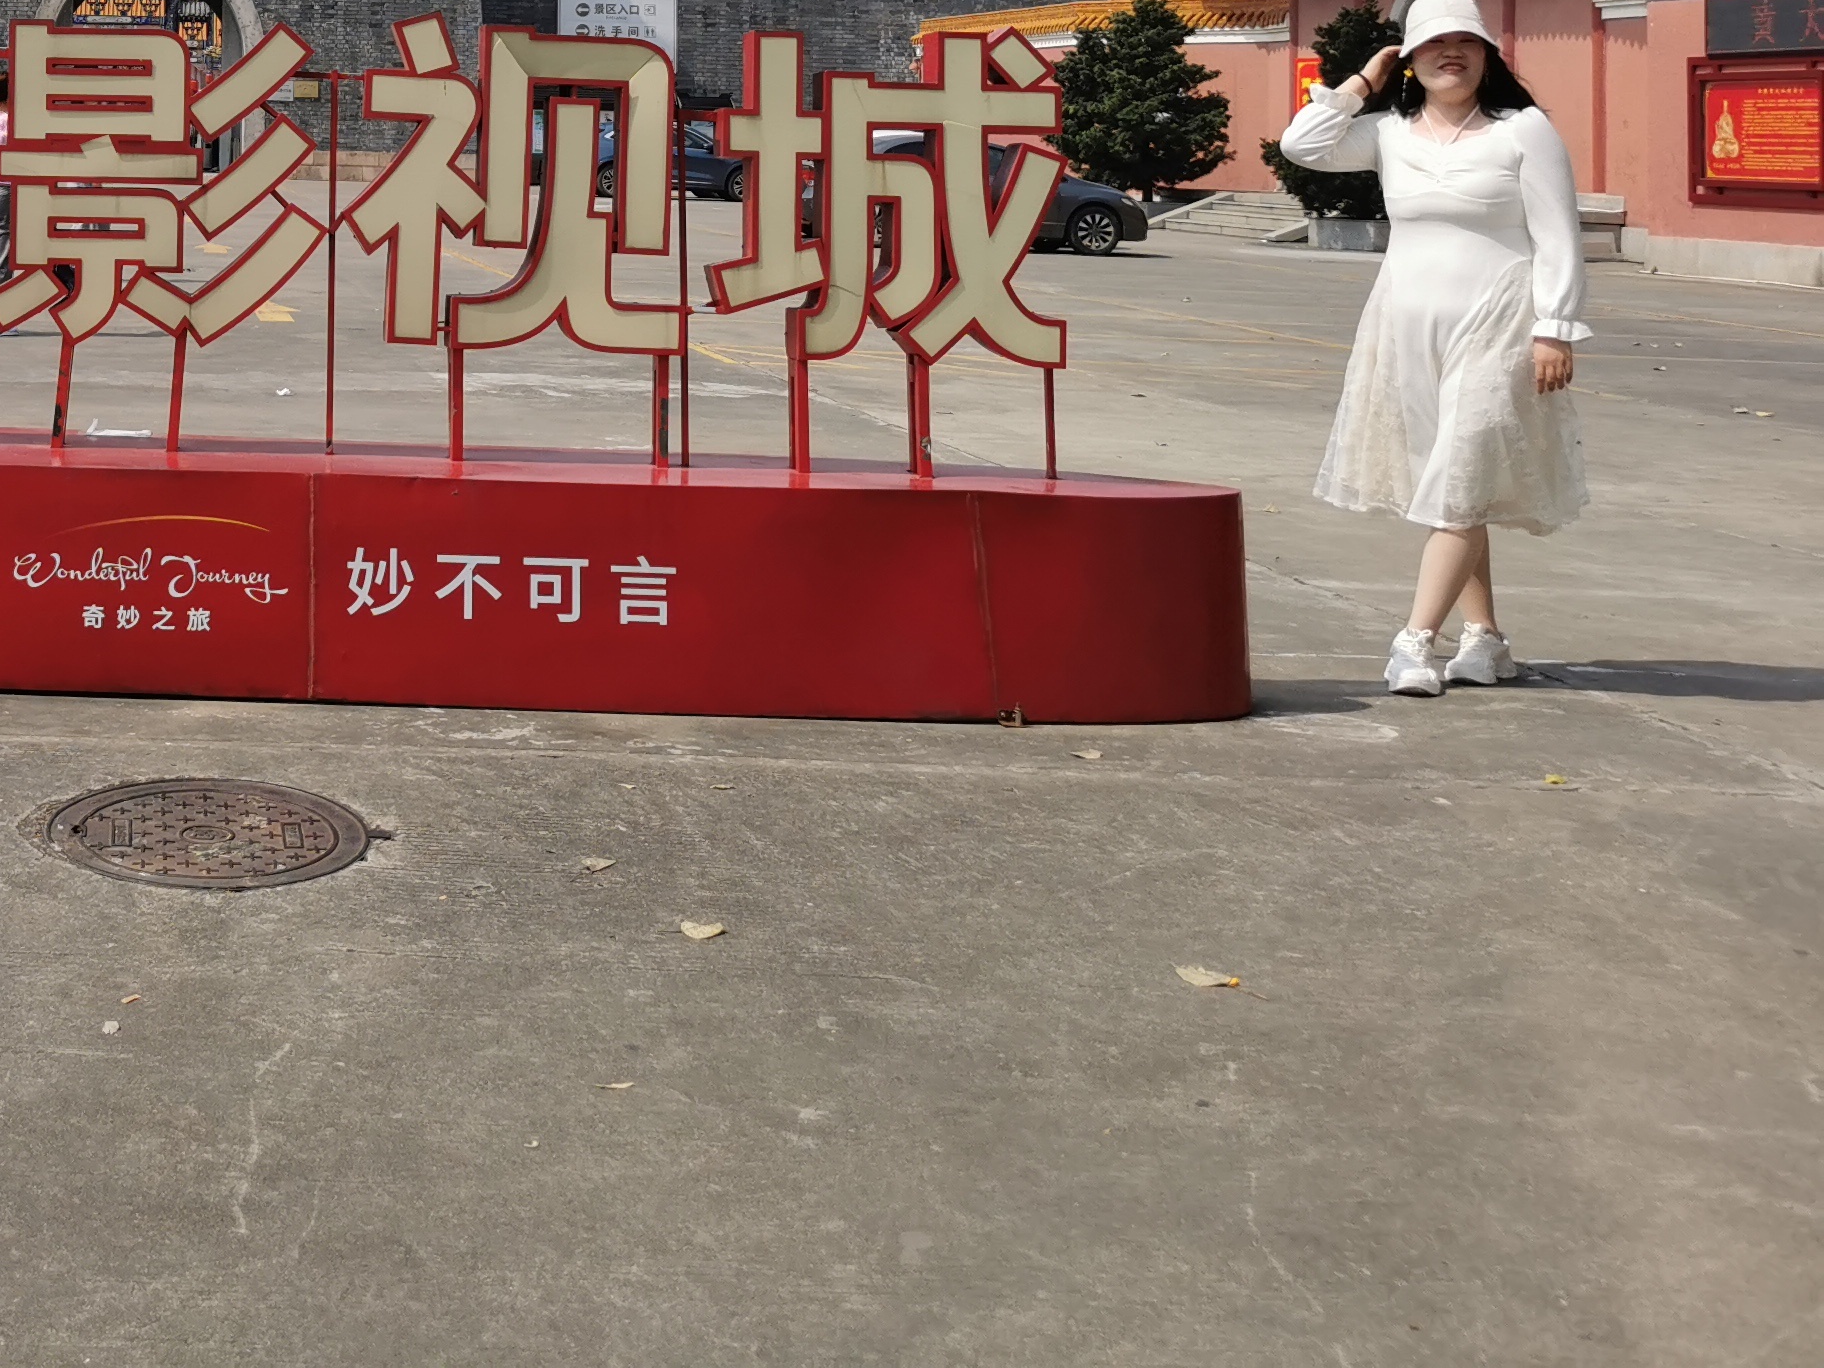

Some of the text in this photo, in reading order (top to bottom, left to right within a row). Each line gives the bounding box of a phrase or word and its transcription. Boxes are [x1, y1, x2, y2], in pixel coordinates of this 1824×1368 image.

[594, 3, 640, 15] 景区入口
[594, 25, 639, 38] 洗手间
[14, 548, 288, 603] Wonderful Journey
[347, 547, 676, 625] 妙不可言
[82, 604, 210, 631] 奇妙之旅
